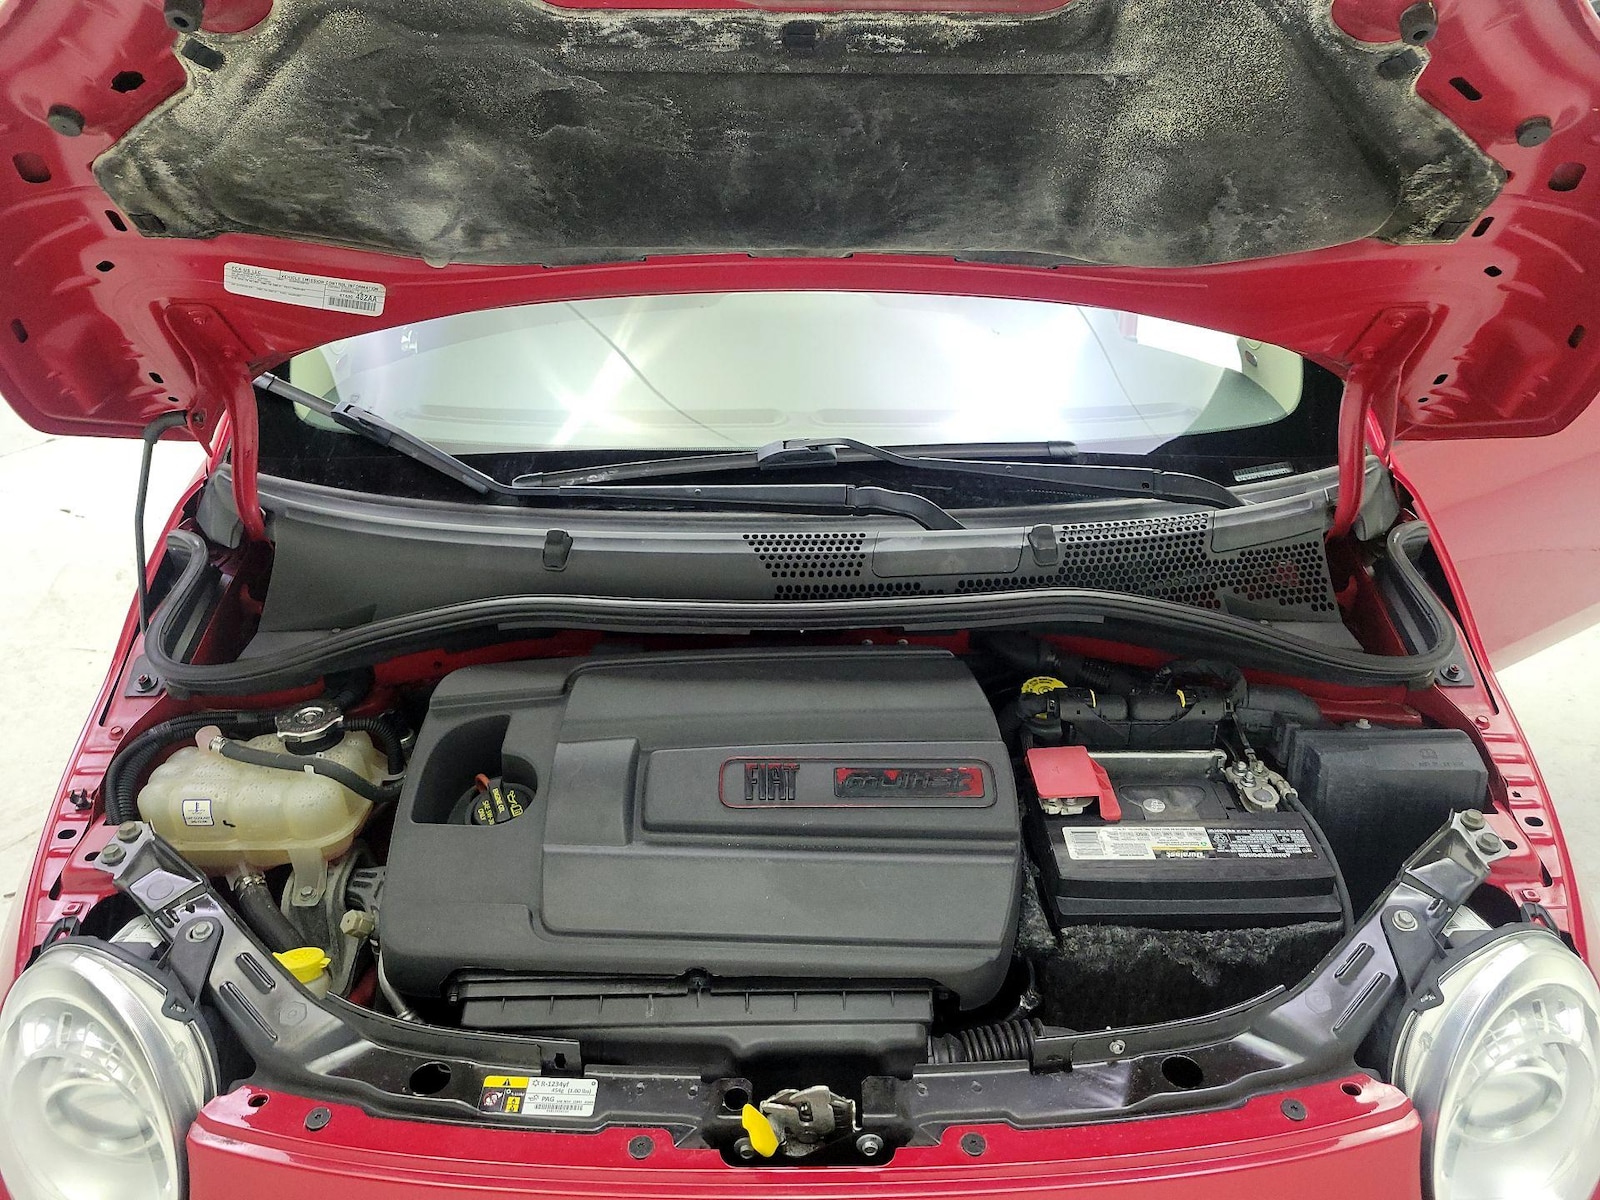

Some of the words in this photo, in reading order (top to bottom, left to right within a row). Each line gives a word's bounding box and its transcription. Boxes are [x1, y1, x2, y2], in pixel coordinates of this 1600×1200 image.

[347, 283, 379, 292] INFORMATION
[745, 763, 800, 800] FIAT
[477, 808, 486, 821] ONLY
[541, 1080, 570, 1088] R-1234yf
